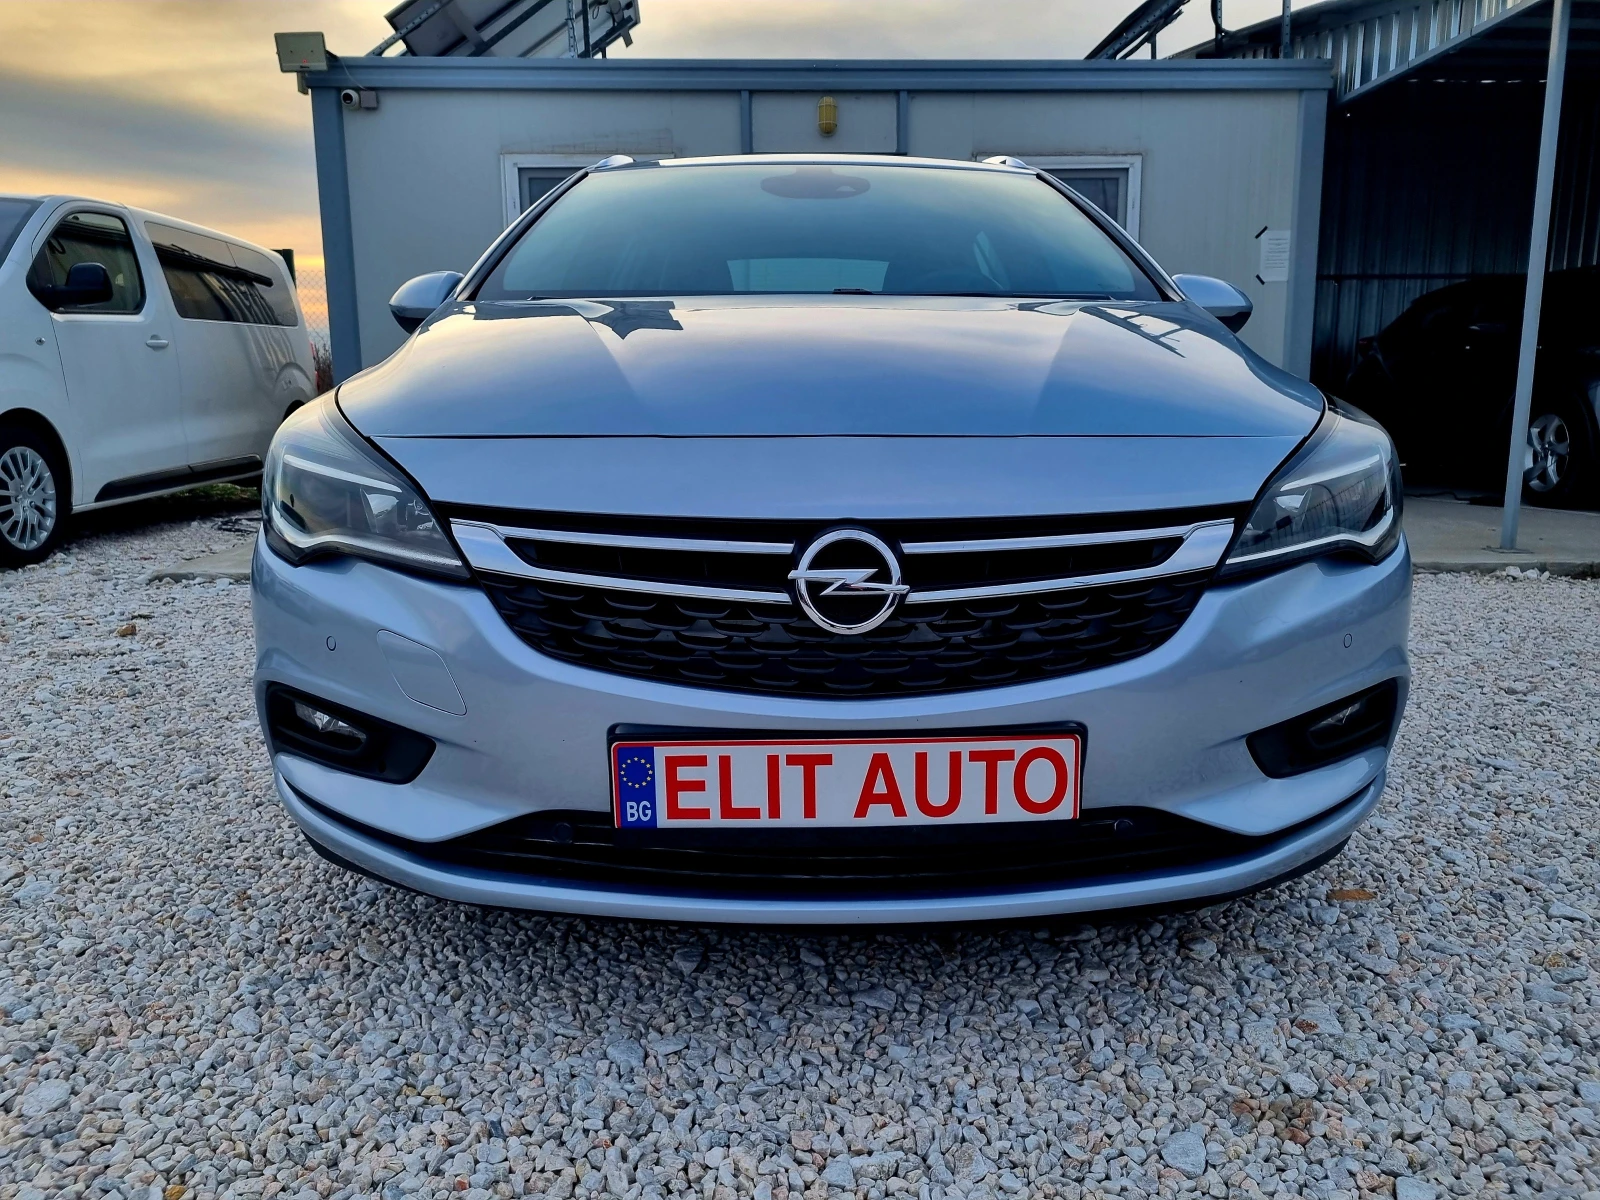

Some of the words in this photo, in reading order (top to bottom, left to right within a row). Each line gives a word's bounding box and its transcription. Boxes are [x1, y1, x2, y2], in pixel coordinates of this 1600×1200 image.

[664, 754, 833, 820] ELIT
[853, 746, 1068, 818] AUTO
[626, 801, 652, 822] BG
